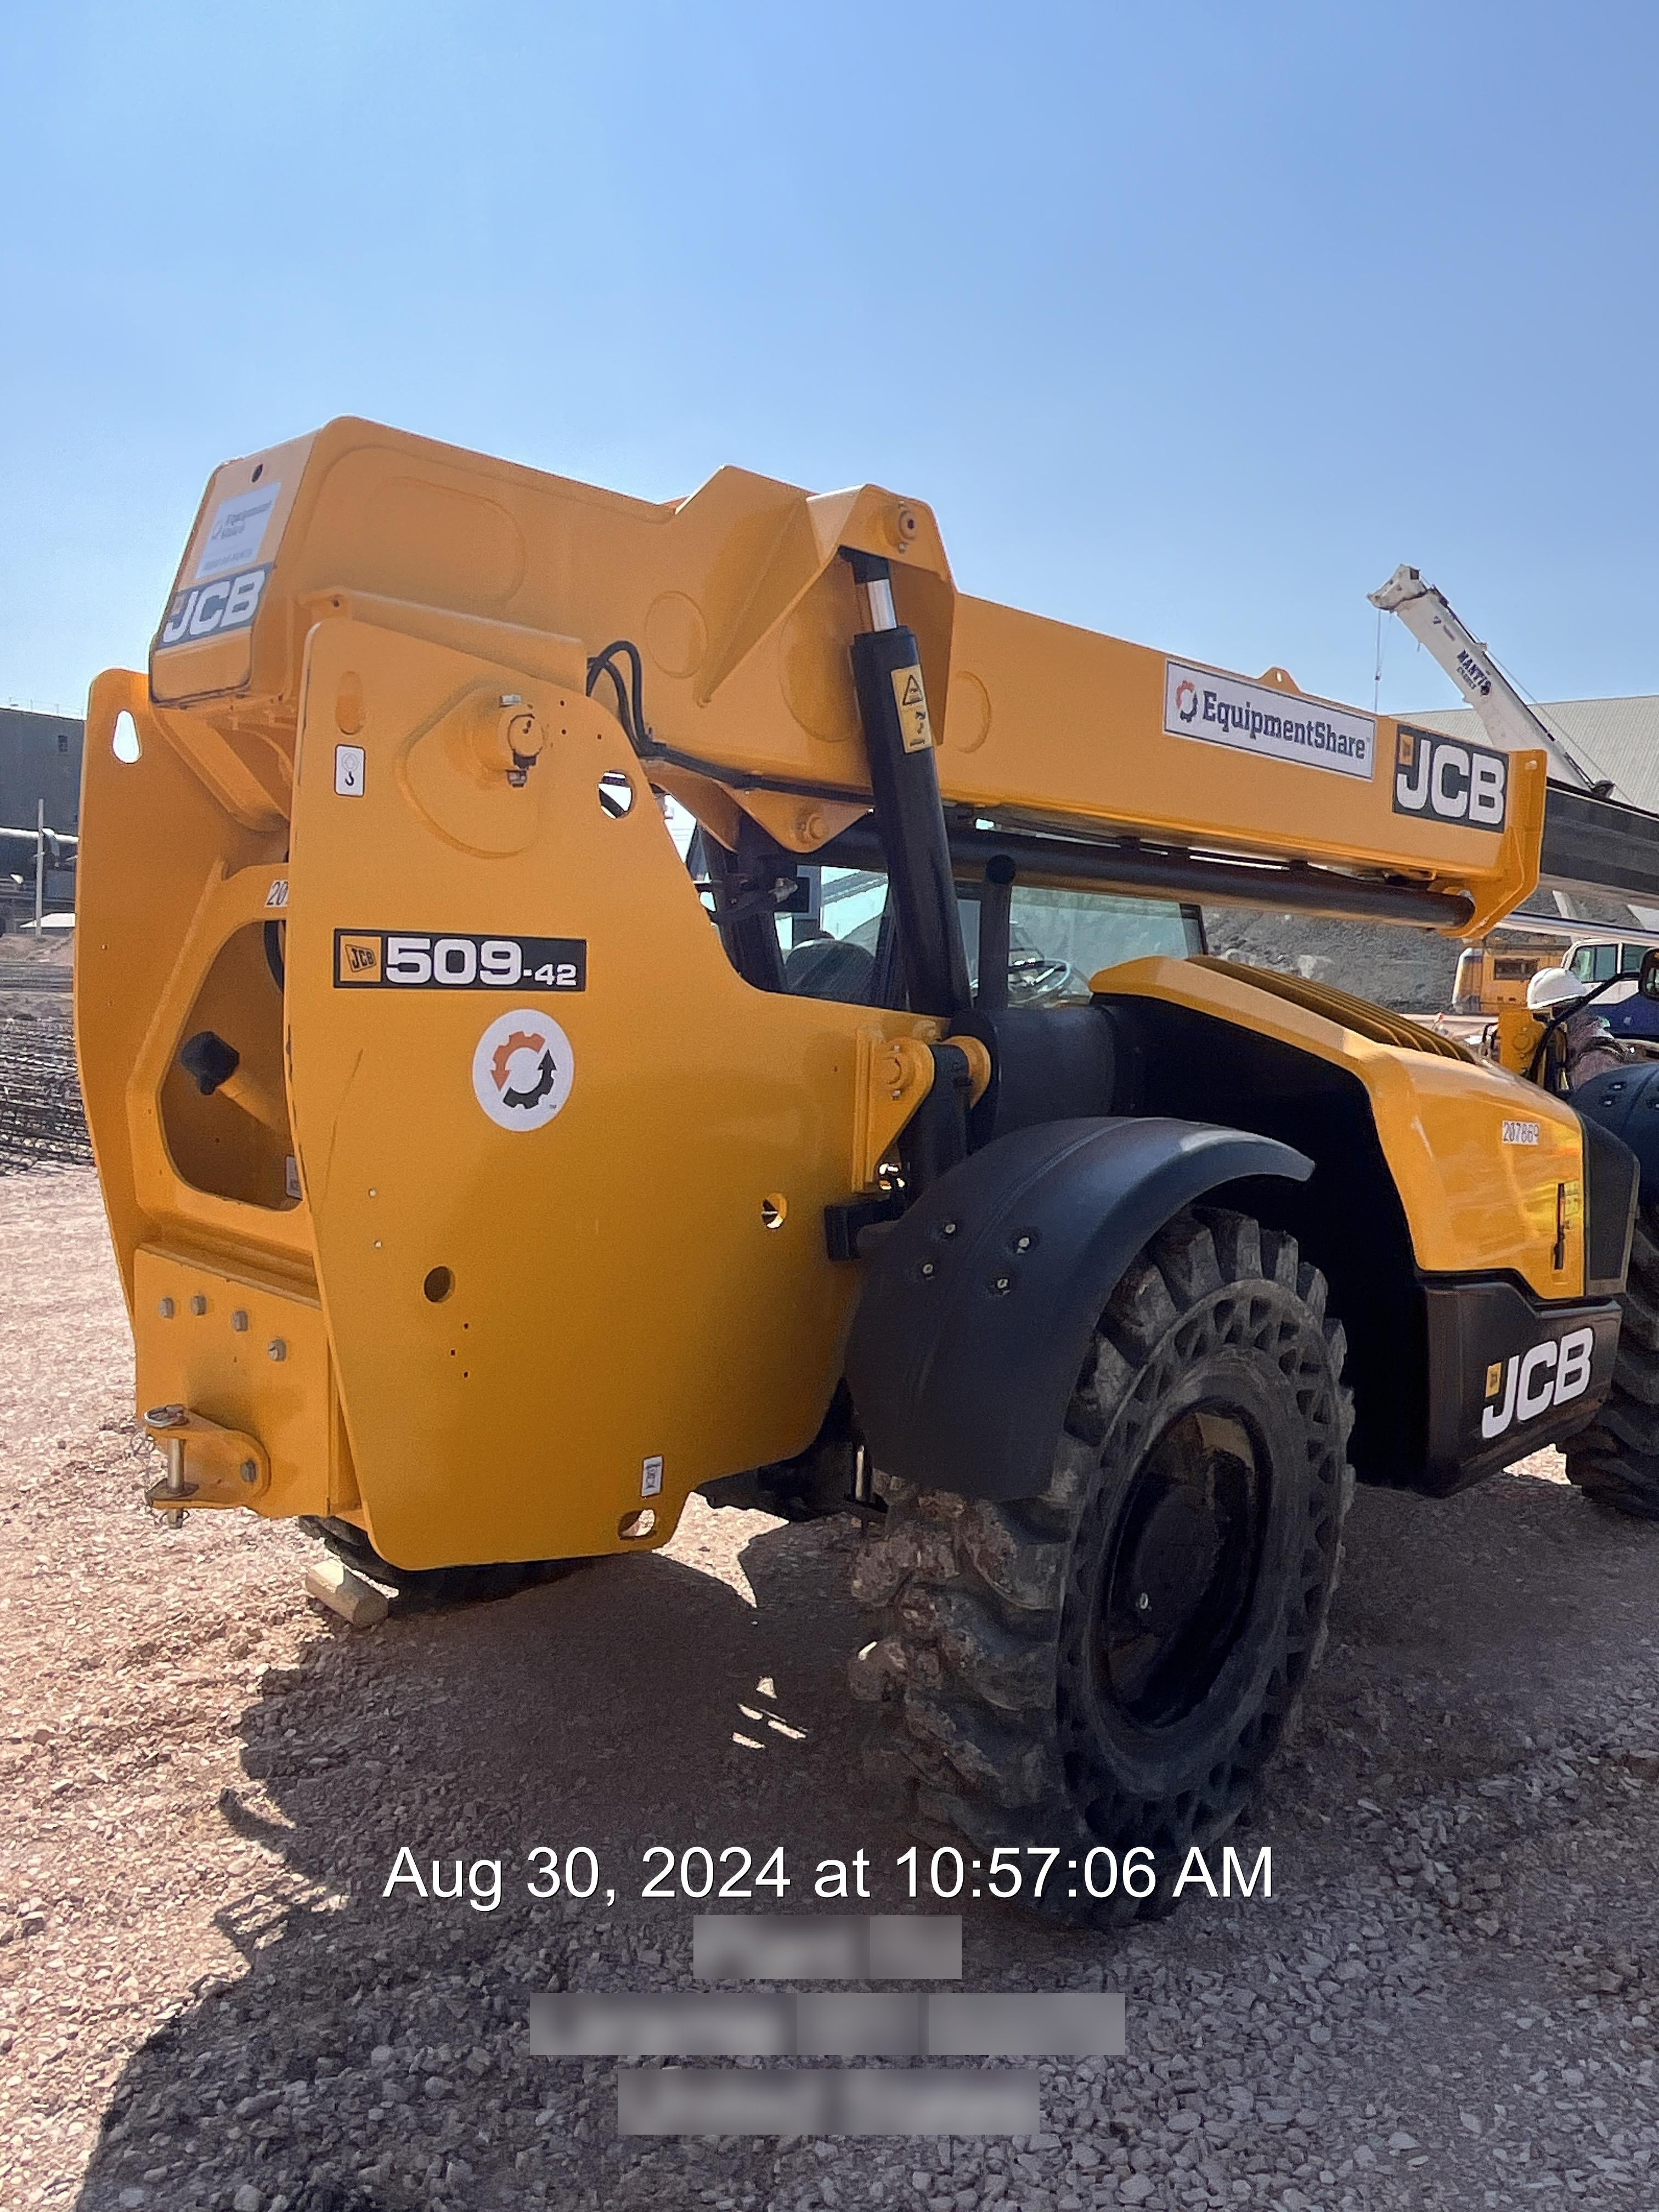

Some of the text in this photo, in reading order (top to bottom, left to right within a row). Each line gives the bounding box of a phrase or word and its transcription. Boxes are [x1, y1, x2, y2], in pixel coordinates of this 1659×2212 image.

[163, 570, 266, 642] JCB
[1457, 649, 1492, 696] MANTIS
[1202, 690, 1366, 760] EquipmentShare
[1396, 738, 1505, 825] JCB
[351, 947, 375, 969] JCB
[386, 936, 577, 986] 509-42
[1481, 1327, 1593, 1438] JCB
